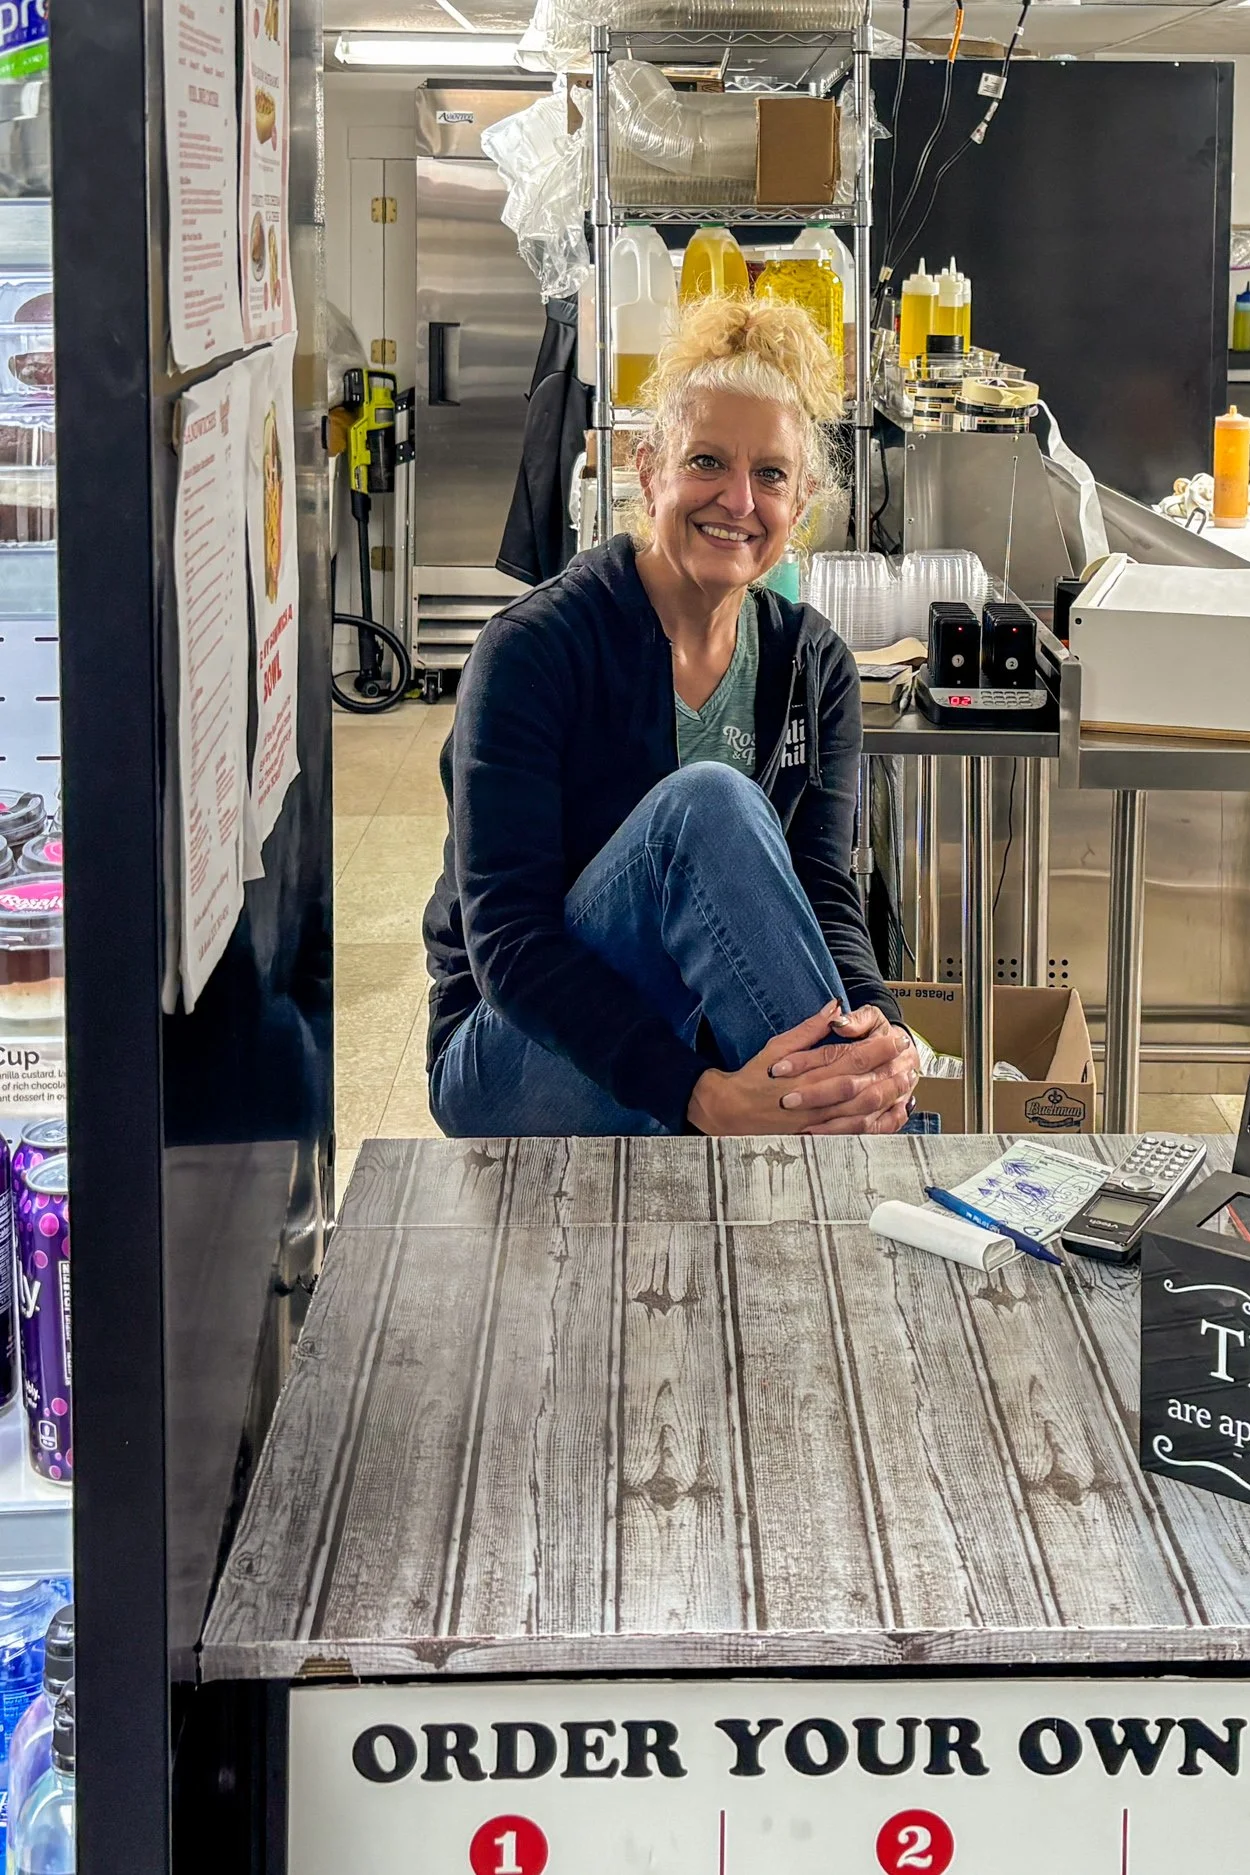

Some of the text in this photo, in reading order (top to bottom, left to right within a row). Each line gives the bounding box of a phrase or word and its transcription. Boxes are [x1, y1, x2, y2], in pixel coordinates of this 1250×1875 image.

[949, 696, 971, 706] 02
[915, 989, 954, 1001] Please
[2, 1082, 11, 1091] of
[13, 1081, 29, 1091] rich
[13, 1092, 45, 1102] dessert
[1167, 1398, 1212, 1431] are
[351, 1719, 689, 1784] ORDER
[714, 1717, 990, 1778] YOUR
[1018, 1717, 1247, 1777] OWN
[494, 1831, 523, 1875] 1
[896, 1825, 933, 1868] 2
